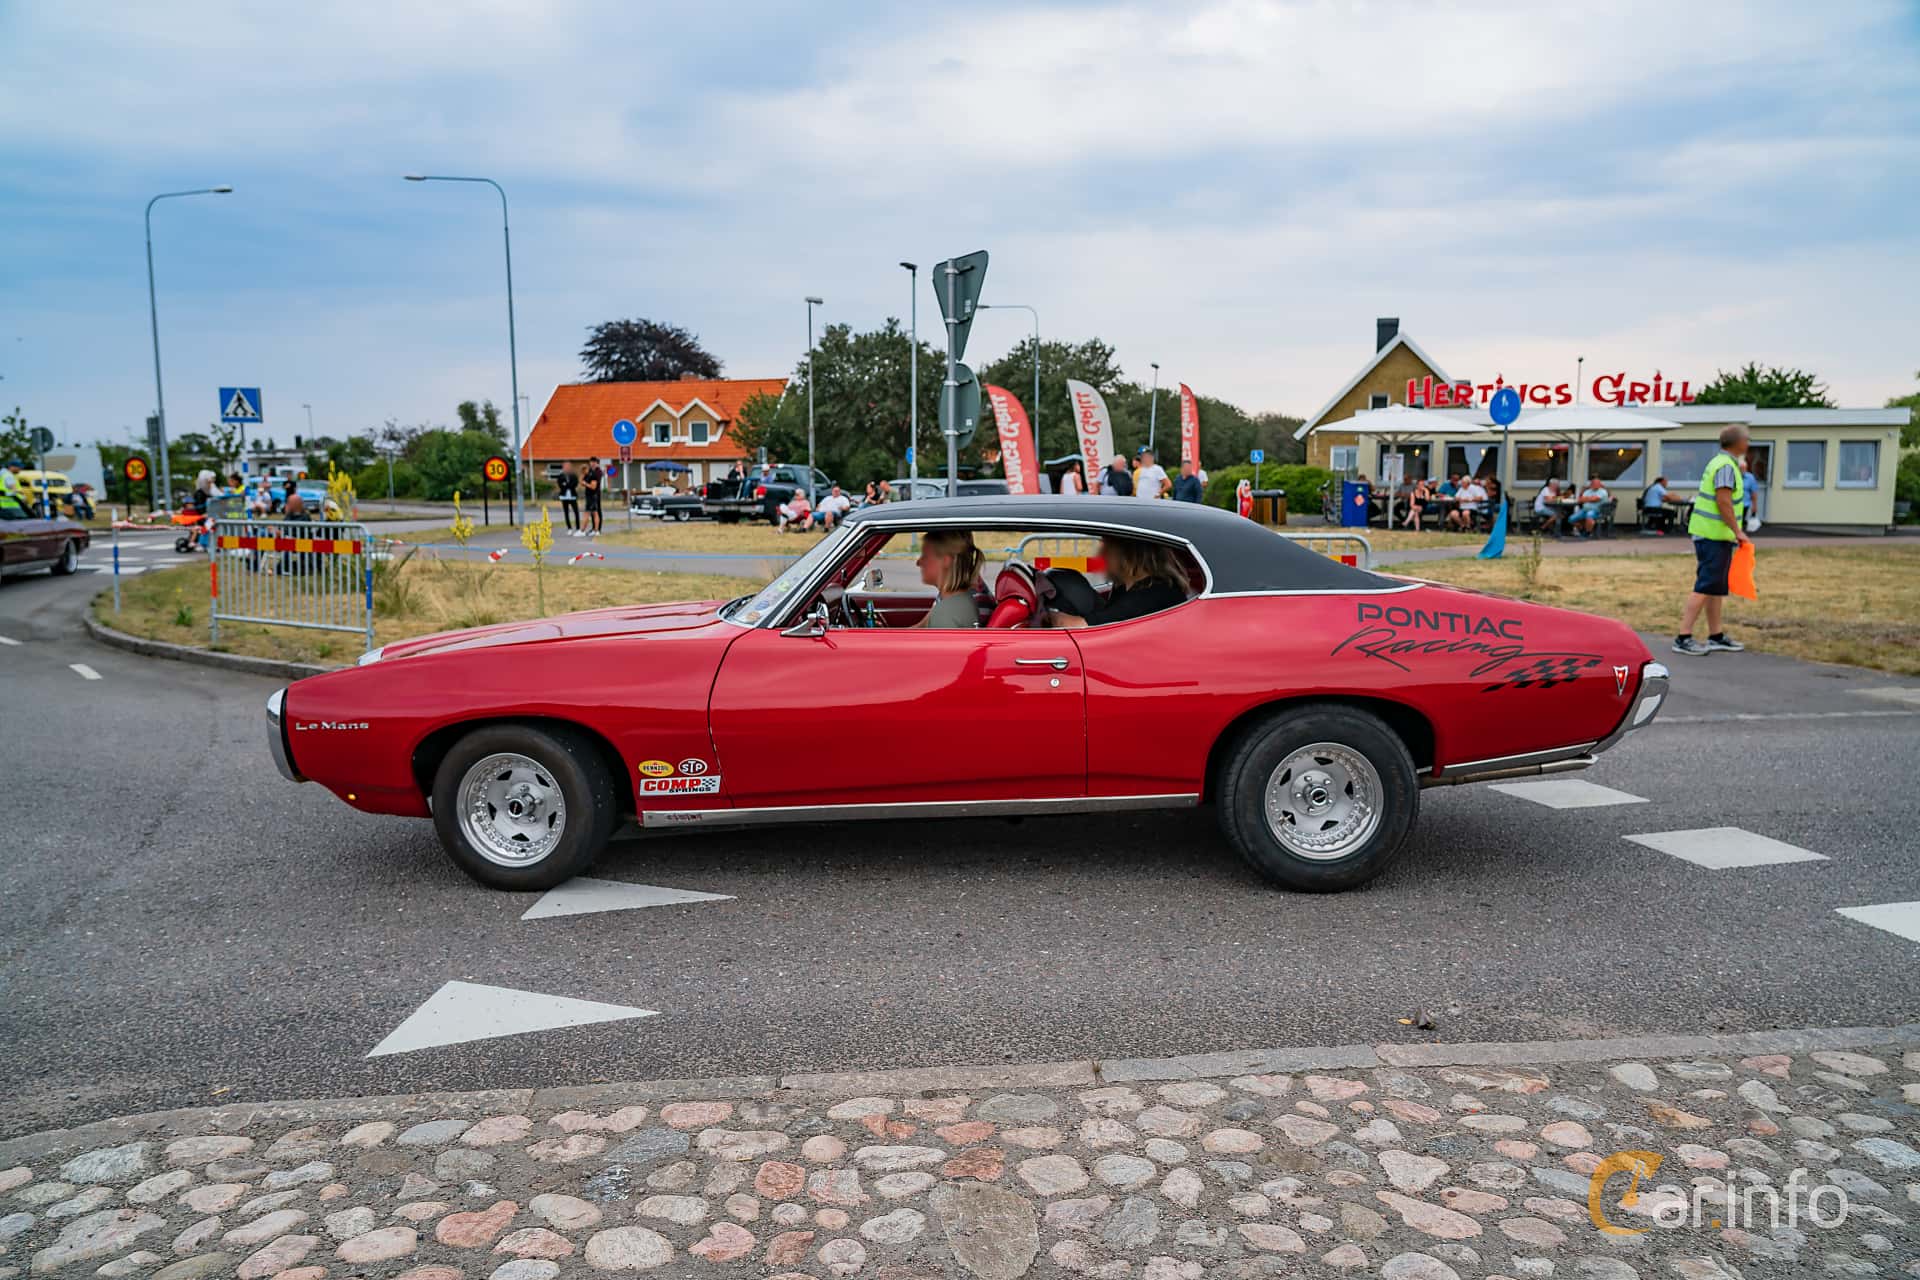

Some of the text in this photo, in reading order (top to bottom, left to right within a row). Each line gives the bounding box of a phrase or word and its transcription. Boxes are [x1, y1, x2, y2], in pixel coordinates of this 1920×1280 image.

[130, 463, 144, 475] 30
[489, 463, 504, 475] 30
[1358, 603, 1523, 640] PONTIAC
[1331, 625, 1603, 677] Racing
[682, 760, 703, 773] STP
[644, 778, 702, 792] COMP
